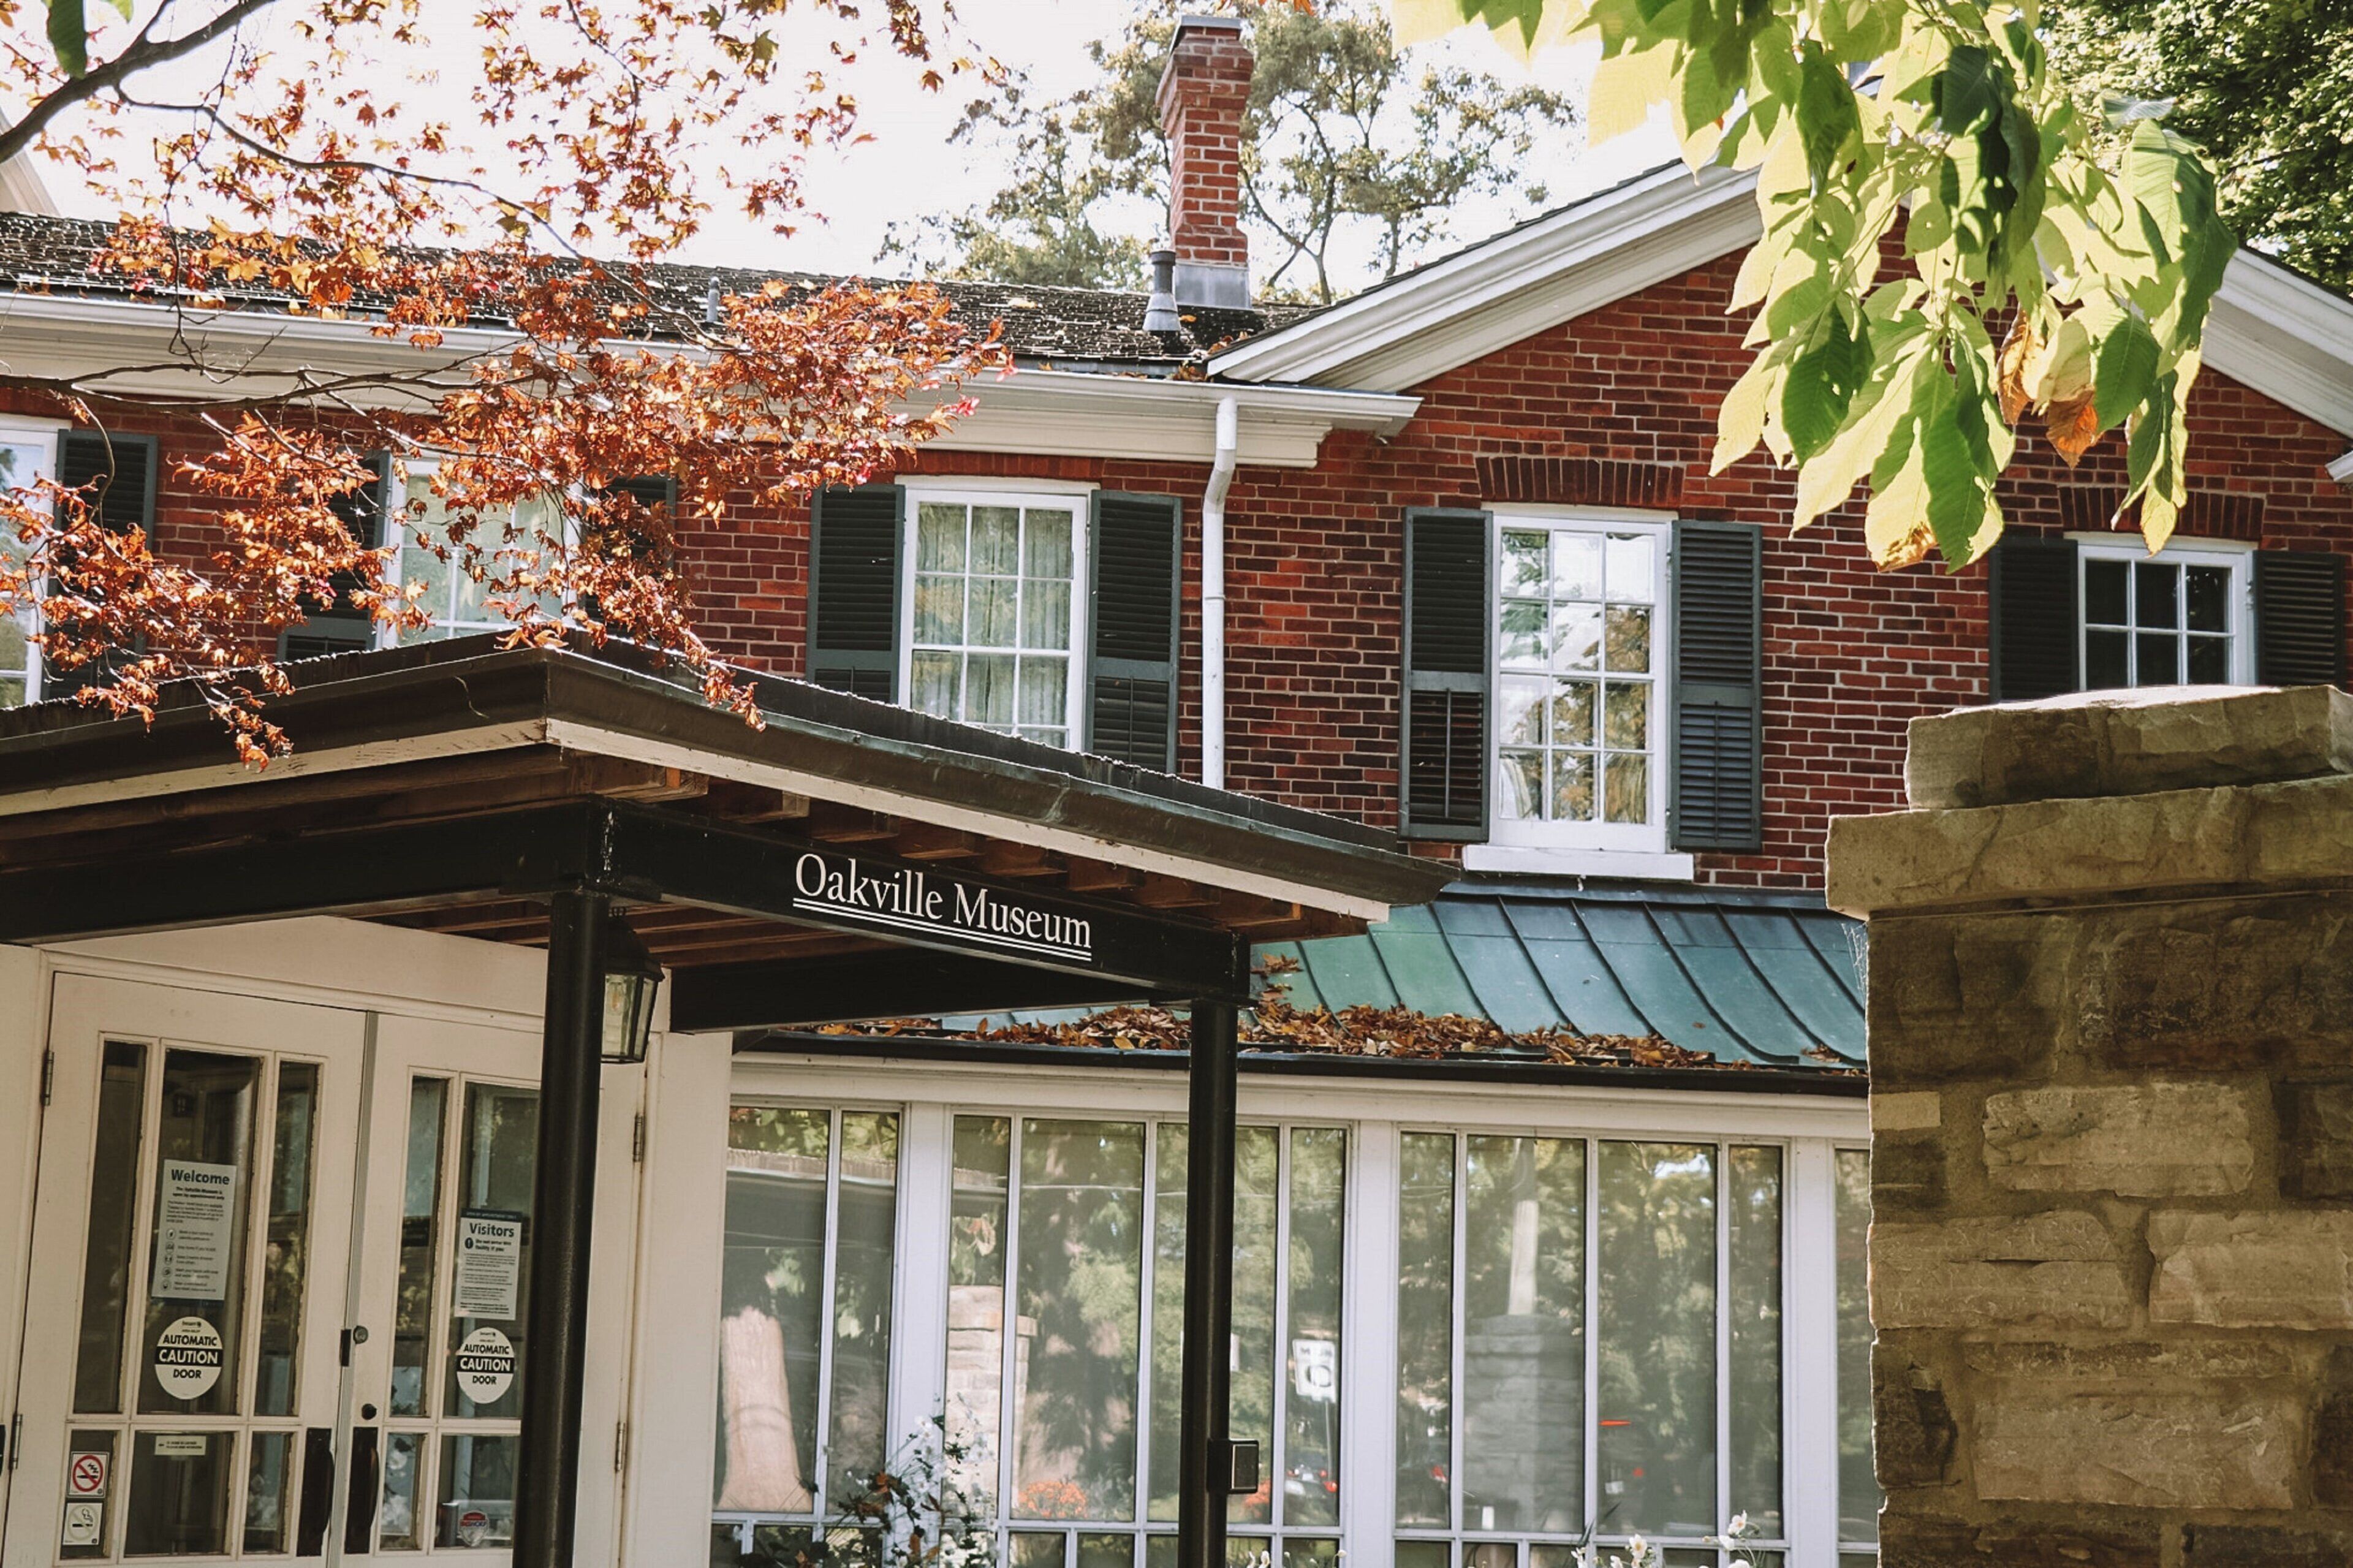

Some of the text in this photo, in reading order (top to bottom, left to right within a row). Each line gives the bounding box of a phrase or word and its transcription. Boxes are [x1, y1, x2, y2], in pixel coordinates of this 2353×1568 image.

[795, 853, 1092, 949] Oakville Museum
[171, 1168, 230, 1185] Welcome
[469, 1222, 515, 1237] Visitors
[162, 1335, 218, 1347] AUTOMATIC
[159, 1349, 218, 1364] CAUTION
[463, 1344, 510, 1355] AUTOMATIC
[460, 1357, 511, 1372] CAUTION
[172, 1368, 202, 1379] DOOR
[472, 1375, 497, 1384] DOOR
